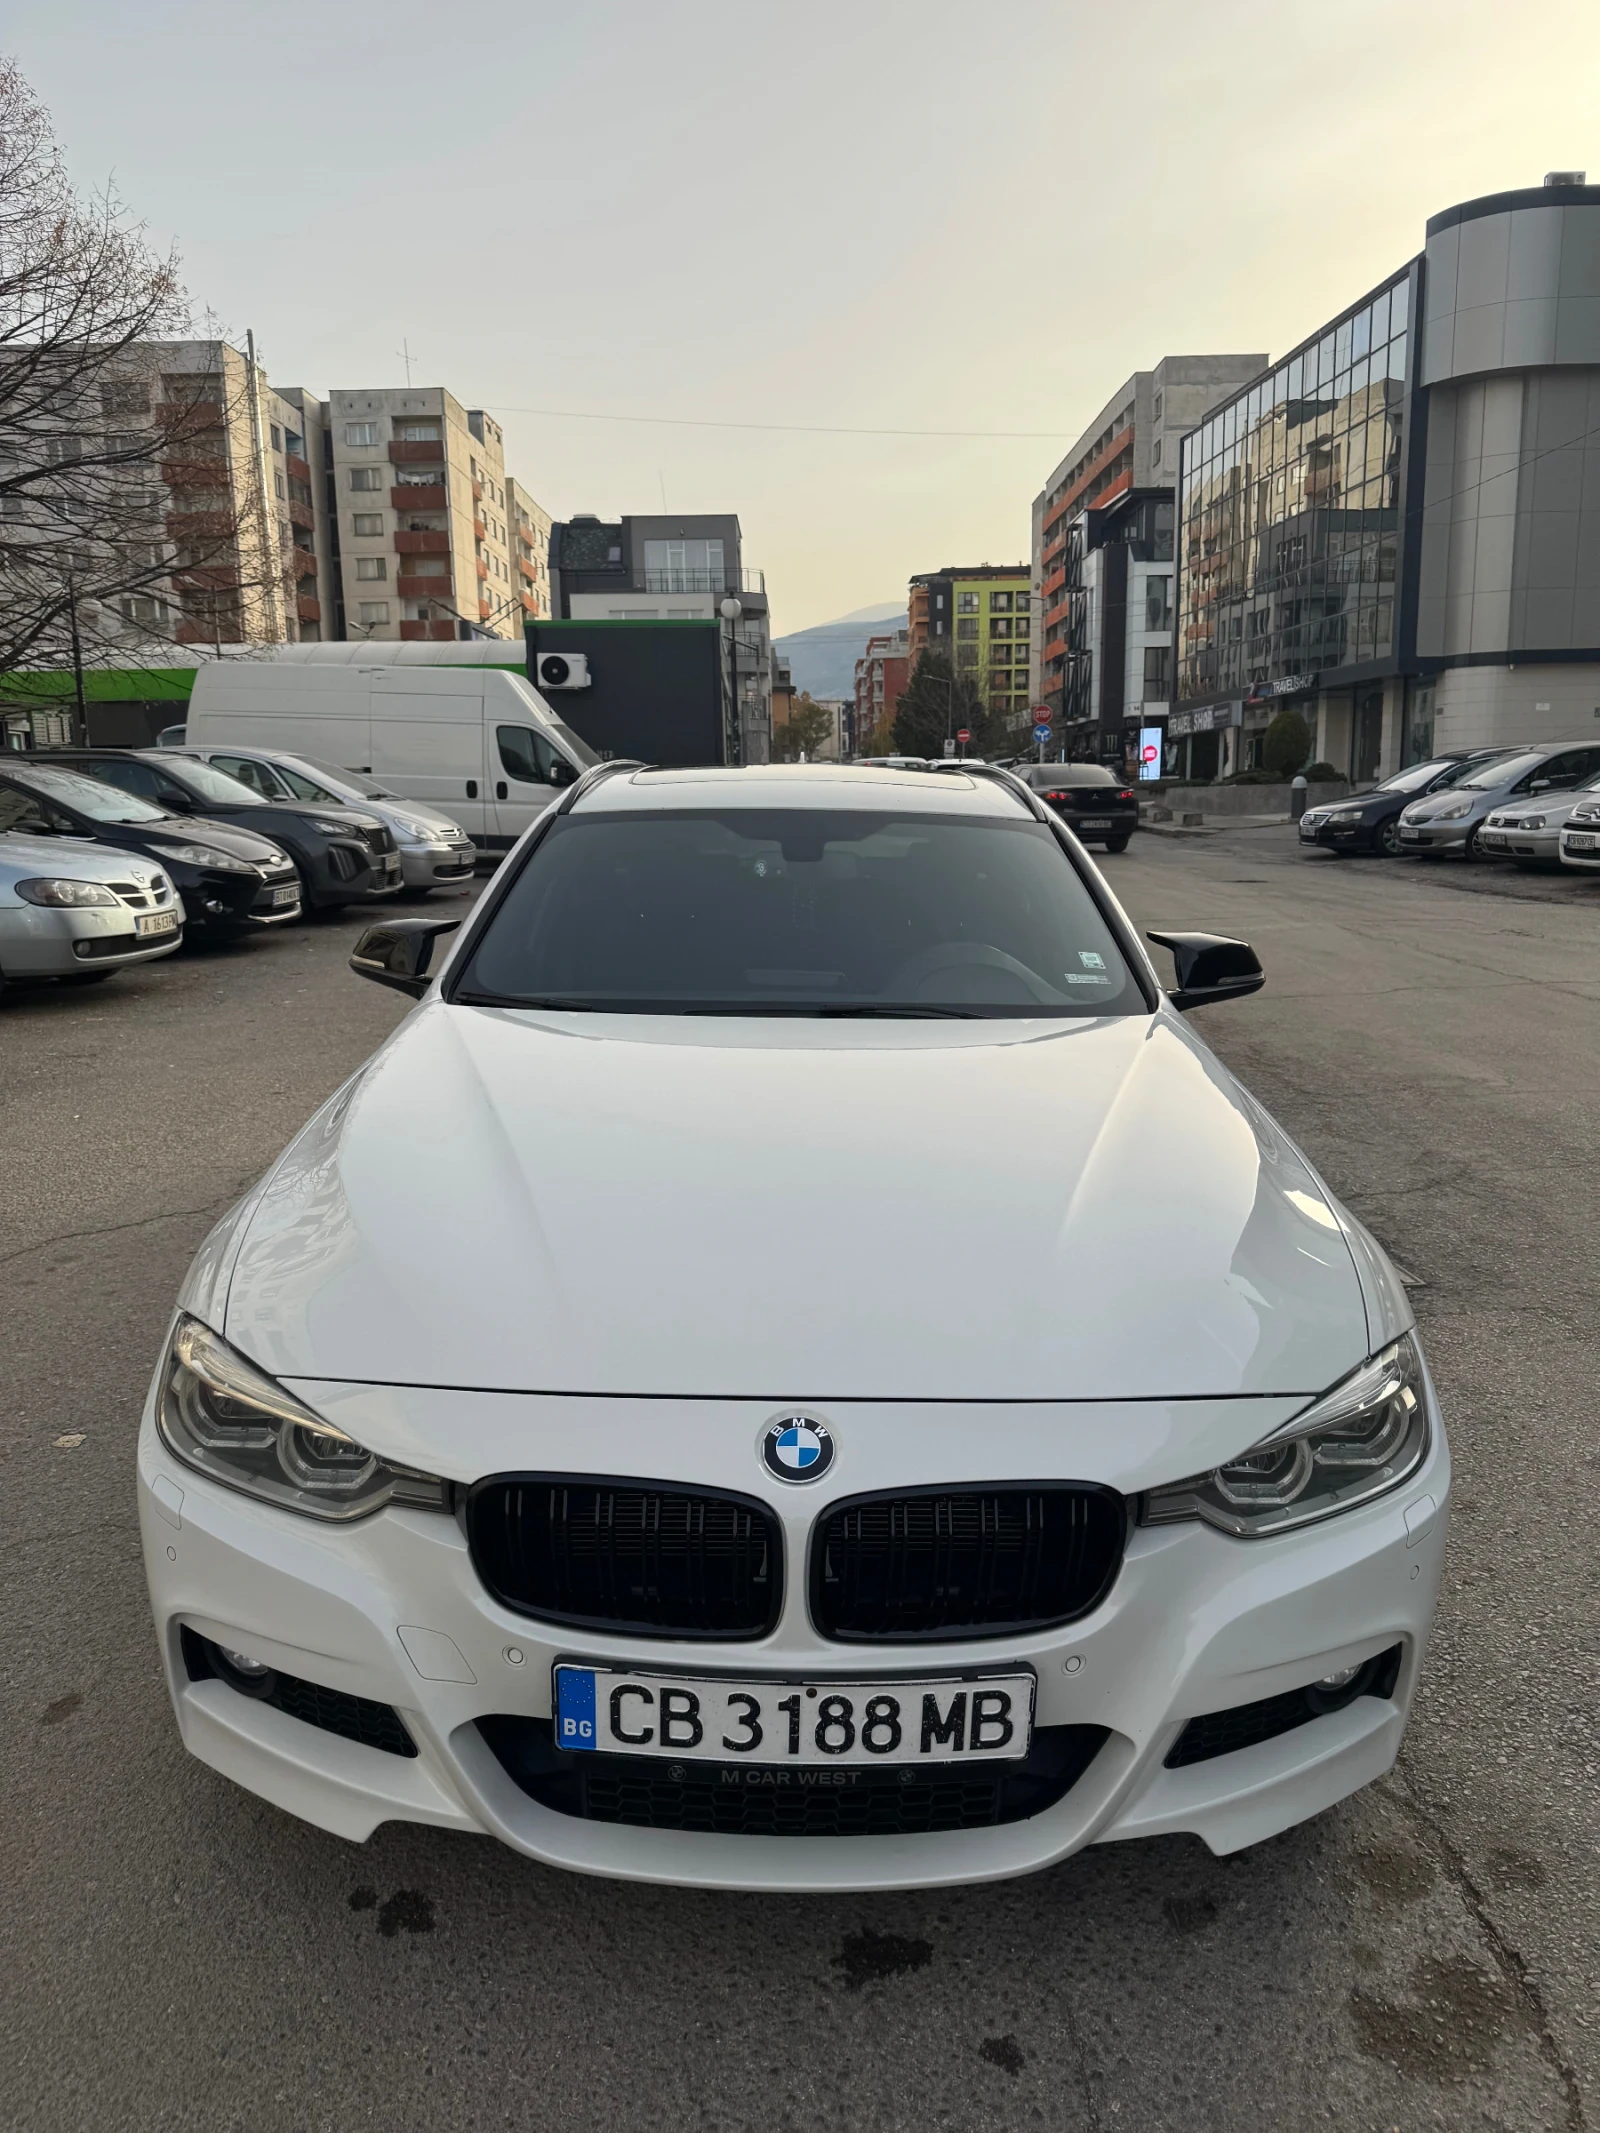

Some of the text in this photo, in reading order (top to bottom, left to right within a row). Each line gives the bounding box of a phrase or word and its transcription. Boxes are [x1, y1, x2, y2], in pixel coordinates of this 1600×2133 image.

[1272, 674, 1313, 694] TRAVEL SHOP
[1035, 710, 1051, 719] STOP
[1168, 716, 1191, 737] TRAVEL
[770, 1418, 829, 1438] BMW
[563, 1718, 592, 1738] BG
[609, 1683, 1014, 1755] CB 3188 MB
[721, 1770, 861, 1785] M CAR WEST
